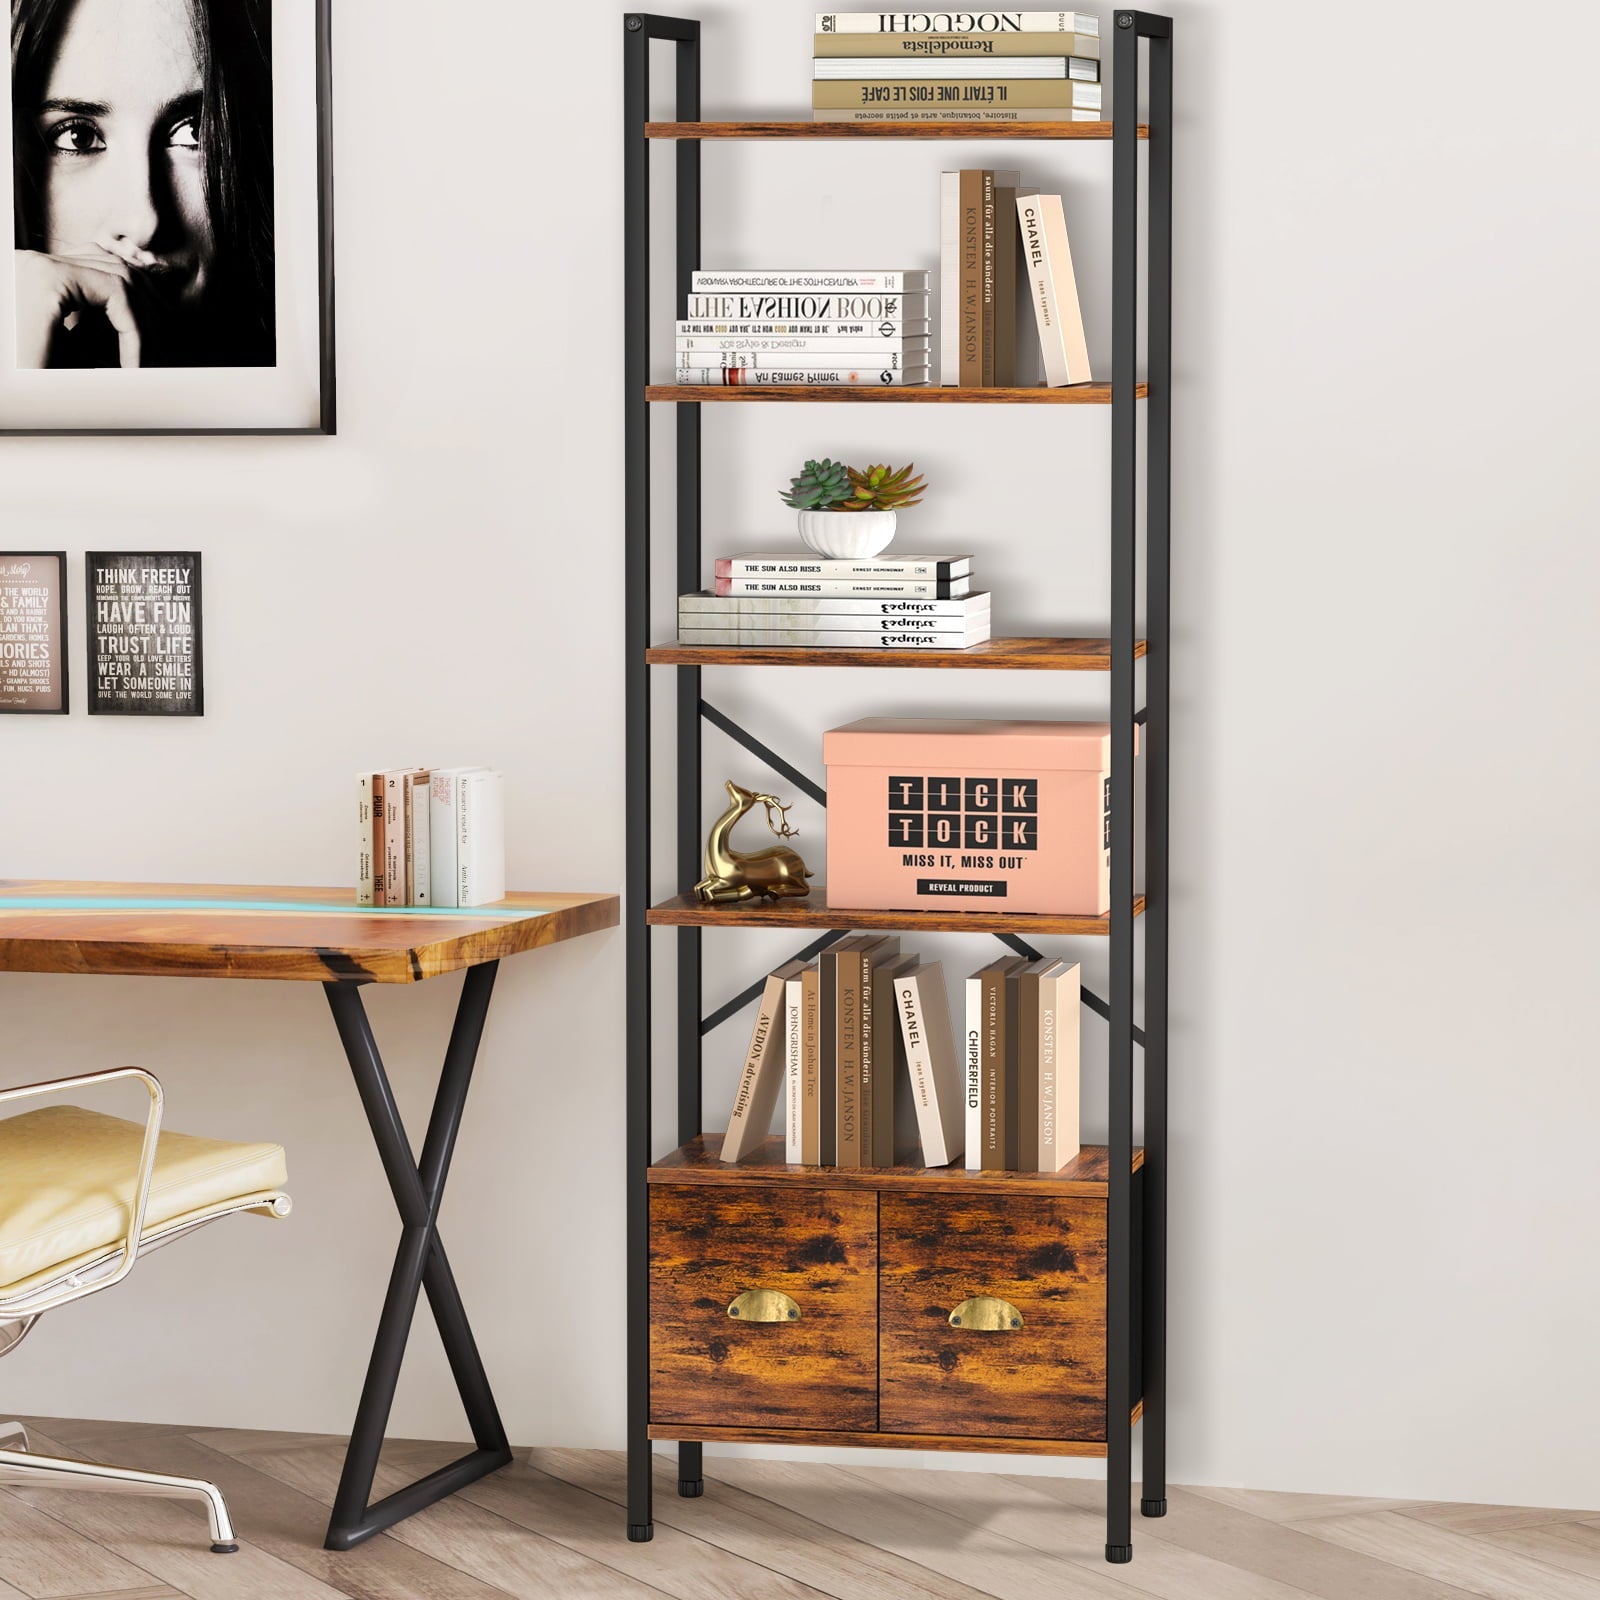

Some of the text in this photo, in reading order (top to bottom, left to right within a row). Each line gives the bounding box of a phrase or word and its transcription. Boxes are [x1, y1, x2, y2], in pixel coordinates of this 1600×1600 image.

[878, 13, 1023, 32] NOGUCHI
[903, 40, 994, 54] Remodelista
[862, 86, 1008, 104] IL ÉTAIT UNE FOIS LE CAFÉ
[886, 112, 909, 121] petits
[940, 112, 982, 121] botanique,
[984, 176, 993, 201] saum
[984, 204, 994, 219] für
[984, 221, 994, 240] alla
[1023, 207, 1043, 268] CHANEL
[984, 242, 994, 257] die
[964, 207, 977, 363] KONSTEN H.W.JANSON
[984, 260, 994, 304] sünderin
[1038, 297, 1052, 327] Leymarie
[96, 568, 191, 584] THINK FREELY
[744, 565, 821, 574] THE SUN ALSO RISES
[21, 587, 49, 596] WORLD
[149, 585, 172, 594] REACH
[176, 585, 191, 594] OUT
[744, 583, 821, 592] THE SUN ALSO RISES
[12, 596, 49, 608] FAMILY
[98, 602, 190, 623] HAVE FUN
[21, 623, 49, 633] THAT?
[97, 624, 191, 634] LAUGH OFTEN & LOUD
[98, 636, 192, 654] TRUST LIFE
[11, 660, 26, 668] AND
[165, 655, 191, 663] LETTERS
[98, 663, 191, 677] WEAR A SMILE
[98, 677, 192, 691] LET SOMEONE IN
[115, 691, 127, 699] THE
[130, 691, 152, 699] WORLD
[155, 691, 173, 699] SOME
[175, 691, 192, 699] LOVE
[360, 779, 366, 787] 1
[389, 780, 395, 788] 2
[897, 782, 1028, 808] TICK
[373, 795, 383, 818] PUUR
[897, 818, 1028, 845] TOCK
[902, 854, 1023, 870] MISS IT, MISS OUT
[374, 874, 384, 893] THEE
[928, 883, 994, 893] REVEAL PRODUCT
[862, 957, 870, 983] saum
[862, 986, 872, 1001] für
[862, 1002, 872, 1021] alla
[902, 989, 921, 1049] CHANEL
[862, 1023, 872, 1039] die
[989, 987, 997, 1058] VICTORIA HAGAN
[806, 989, 817, 1097] At Home in Joshua Tree
[732, 1012, 771, 1119] AVEDON advertising
[842, 988, 854, 1142] KONSTEN H.W.JANSON
[862, 1041, 872, 1084] sünderin
[968, 1030, 979, 1109] CHIPPERFIELD
[1042, 1009, 1053, 1146] KONSTEN H.W.JANSON
[917, 1077, 930, 1108] Leymarie
